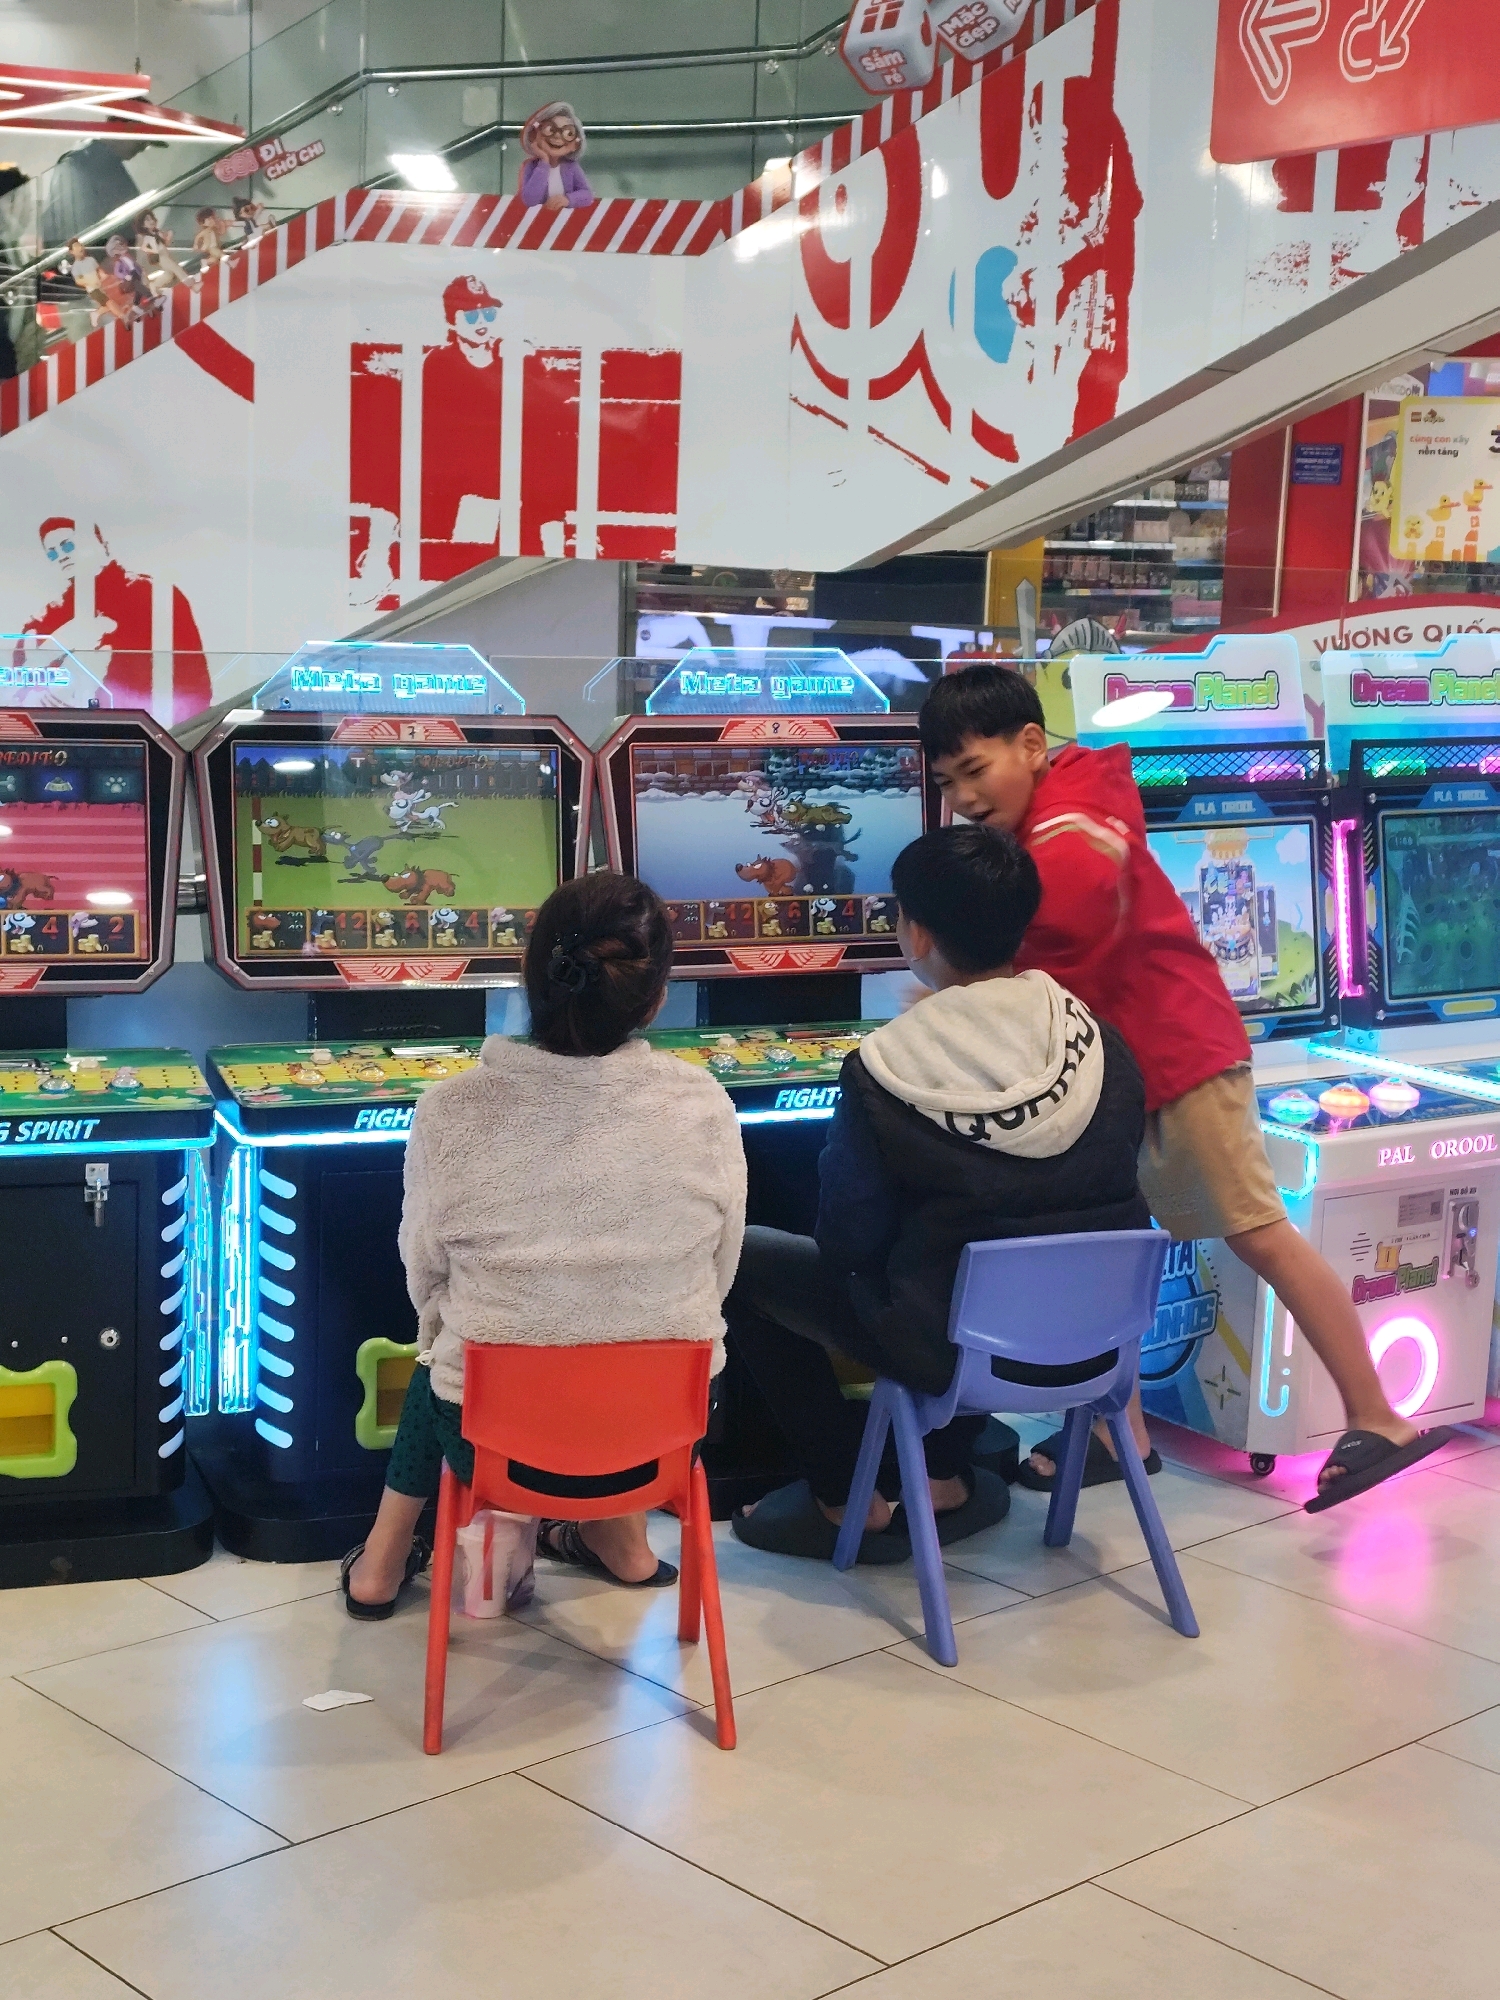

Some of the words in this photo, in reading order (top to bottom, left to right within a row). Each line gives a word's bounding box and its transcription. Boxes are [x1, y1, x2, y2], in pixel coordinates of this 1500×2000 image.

[299, 142, 324, 161] CHI
[0, 667, 71, 687] ame
[291, 666, 382, 693] Meta
[392, 673, 487, 699] game
[680, 671, 762, 696] Meta
[771, 676, 855, 699] game
[1351, 671, 1431, 706] Dream
[1196, 672, 1279, 711] Planet
[41, 916, 60, 935] 4
[108, 916, 125, 934] 2
[774, 1086, 842, 1109] FIGHT
[15, 1119, 101, 1142] SPIRIT
[354, 1107, 414, 1129] FIGH
[1378, 1144, 1416, 1167] PAL
[1430, 1133, 1499, 1160] OROOL
[1396, 1256, 1440, 1293] Planet
[1141, 1292, 1218, 1350] ONHOS
